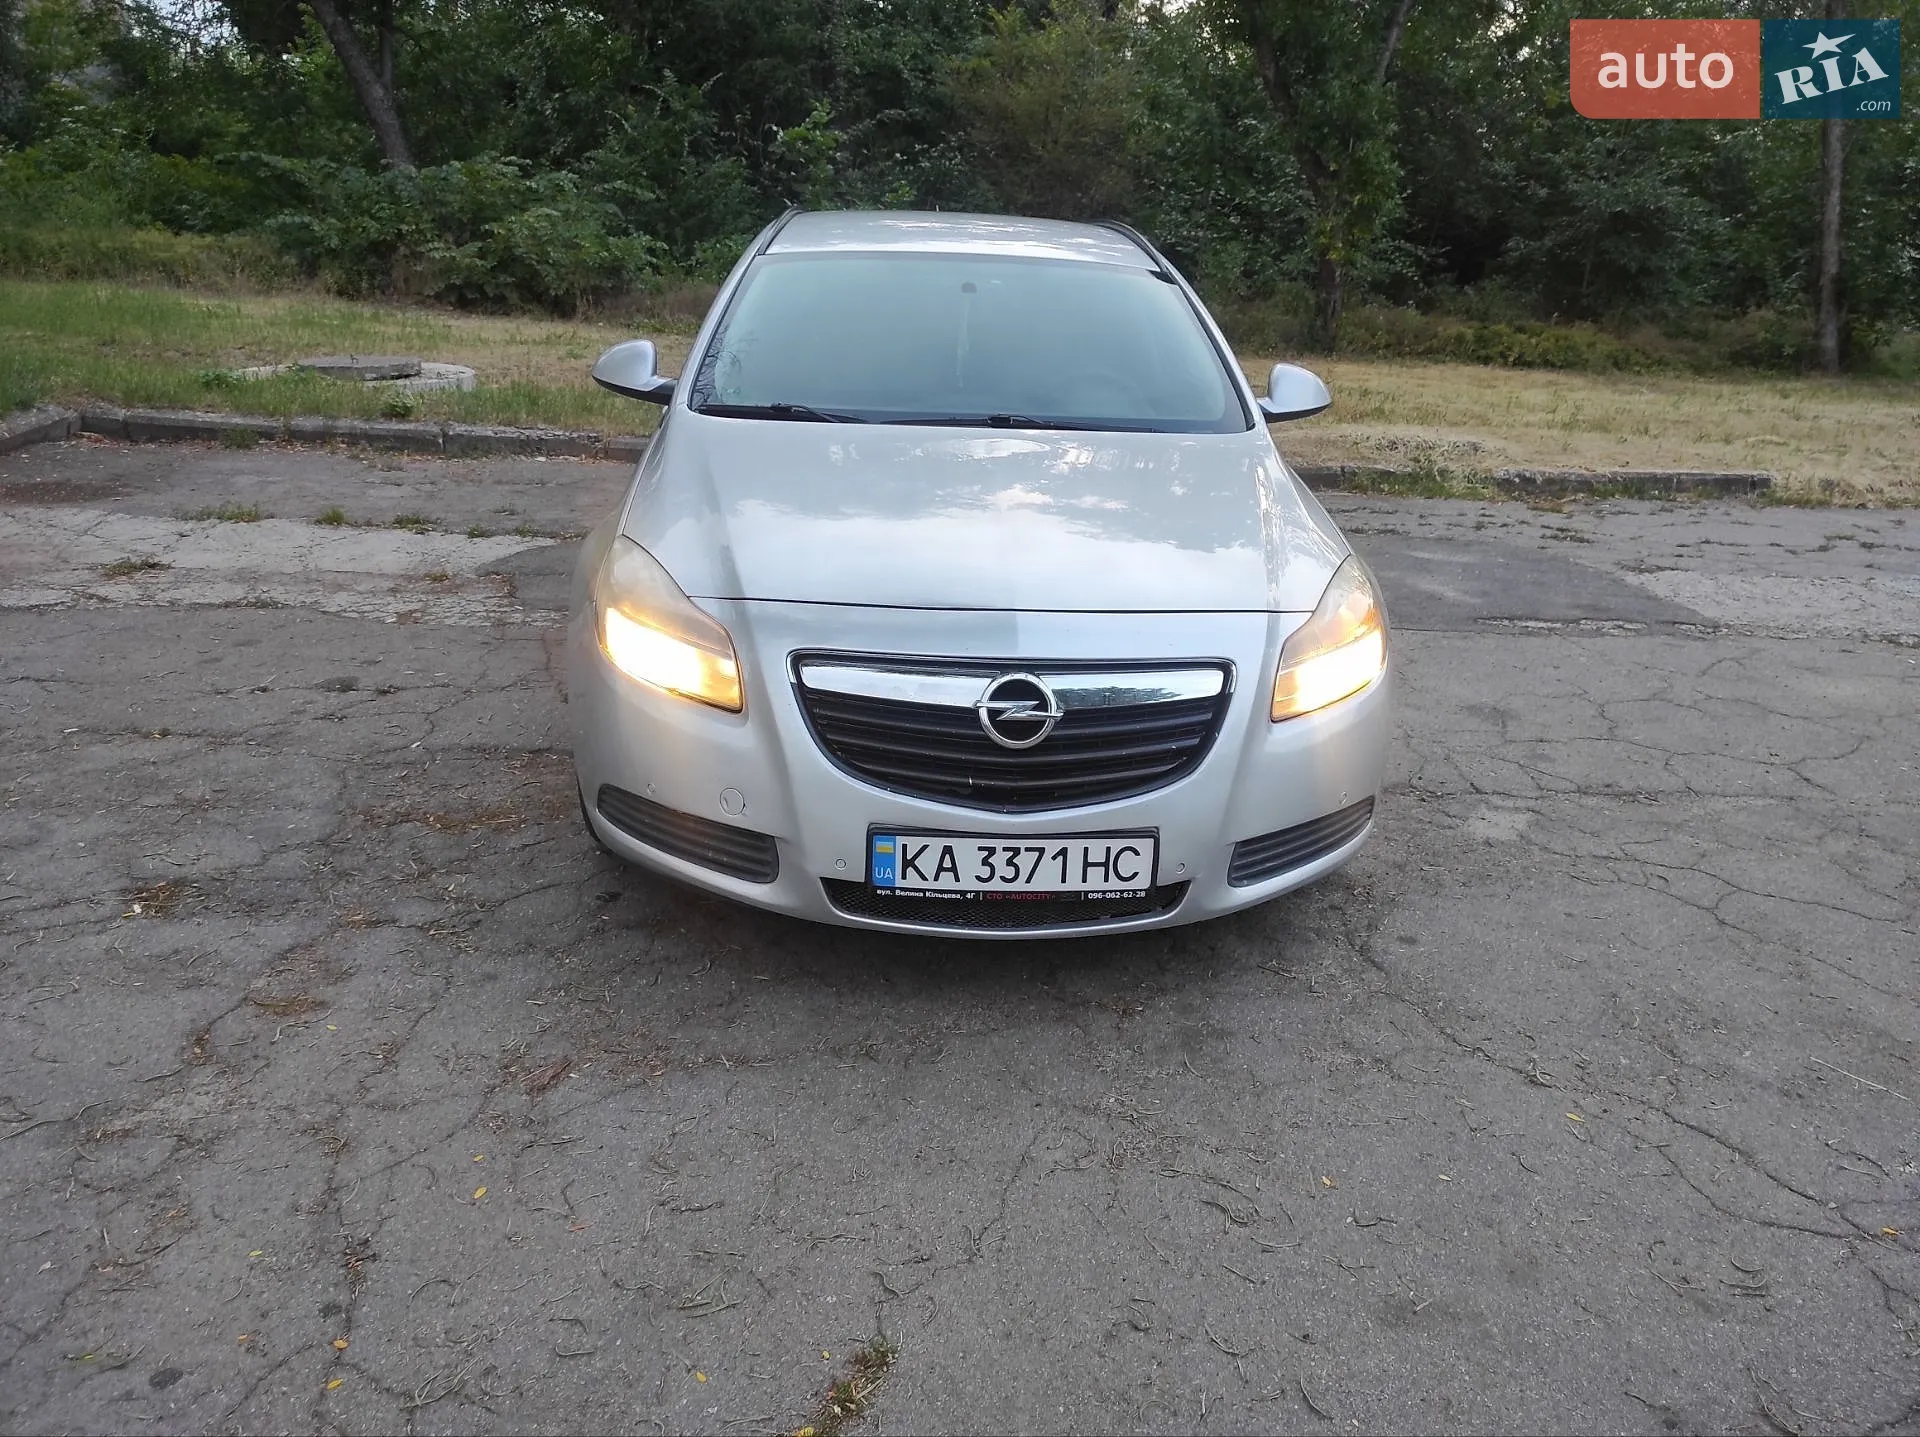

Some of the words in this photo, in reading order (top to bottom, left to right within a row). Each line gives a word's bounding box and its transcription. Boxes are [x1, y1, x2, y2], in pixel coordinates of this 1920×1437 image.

[875, 867, 893, 880] UA
[901, 843, 961, 883] KA
[974, 846, 1068, 884] 3371
[1082, 846, 1141, 884] HC
